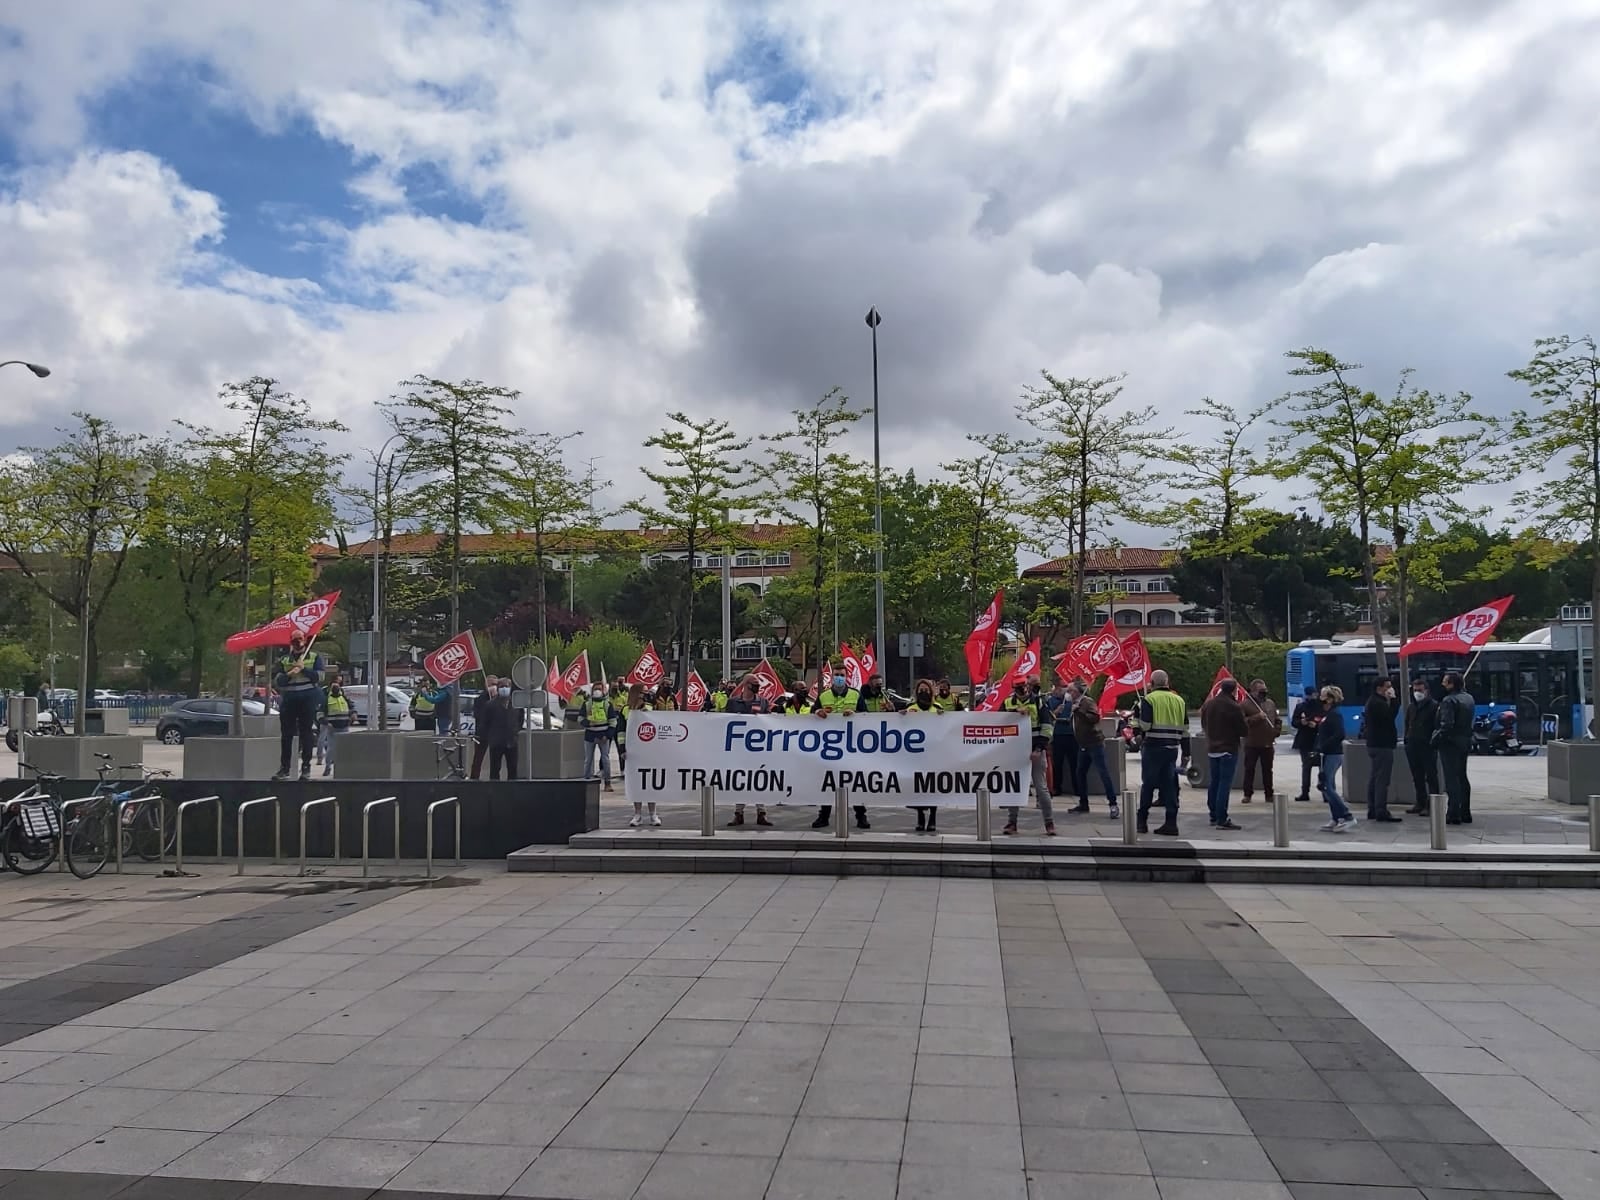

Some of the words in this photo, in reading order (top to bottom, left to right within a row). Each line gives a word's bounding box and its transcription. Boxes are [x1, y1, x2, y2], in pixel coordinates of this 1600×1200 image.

[725, 721, 925, 760] Ferroglobe
[963, 737, 1005, 745] industria
[638, 768, 666, 790] TU
[678, 764, 793, 798] TRAICIÓN,
[821, 770, 901, 794] APAGA
[914, 766, 1021, 794] MONZÓN
